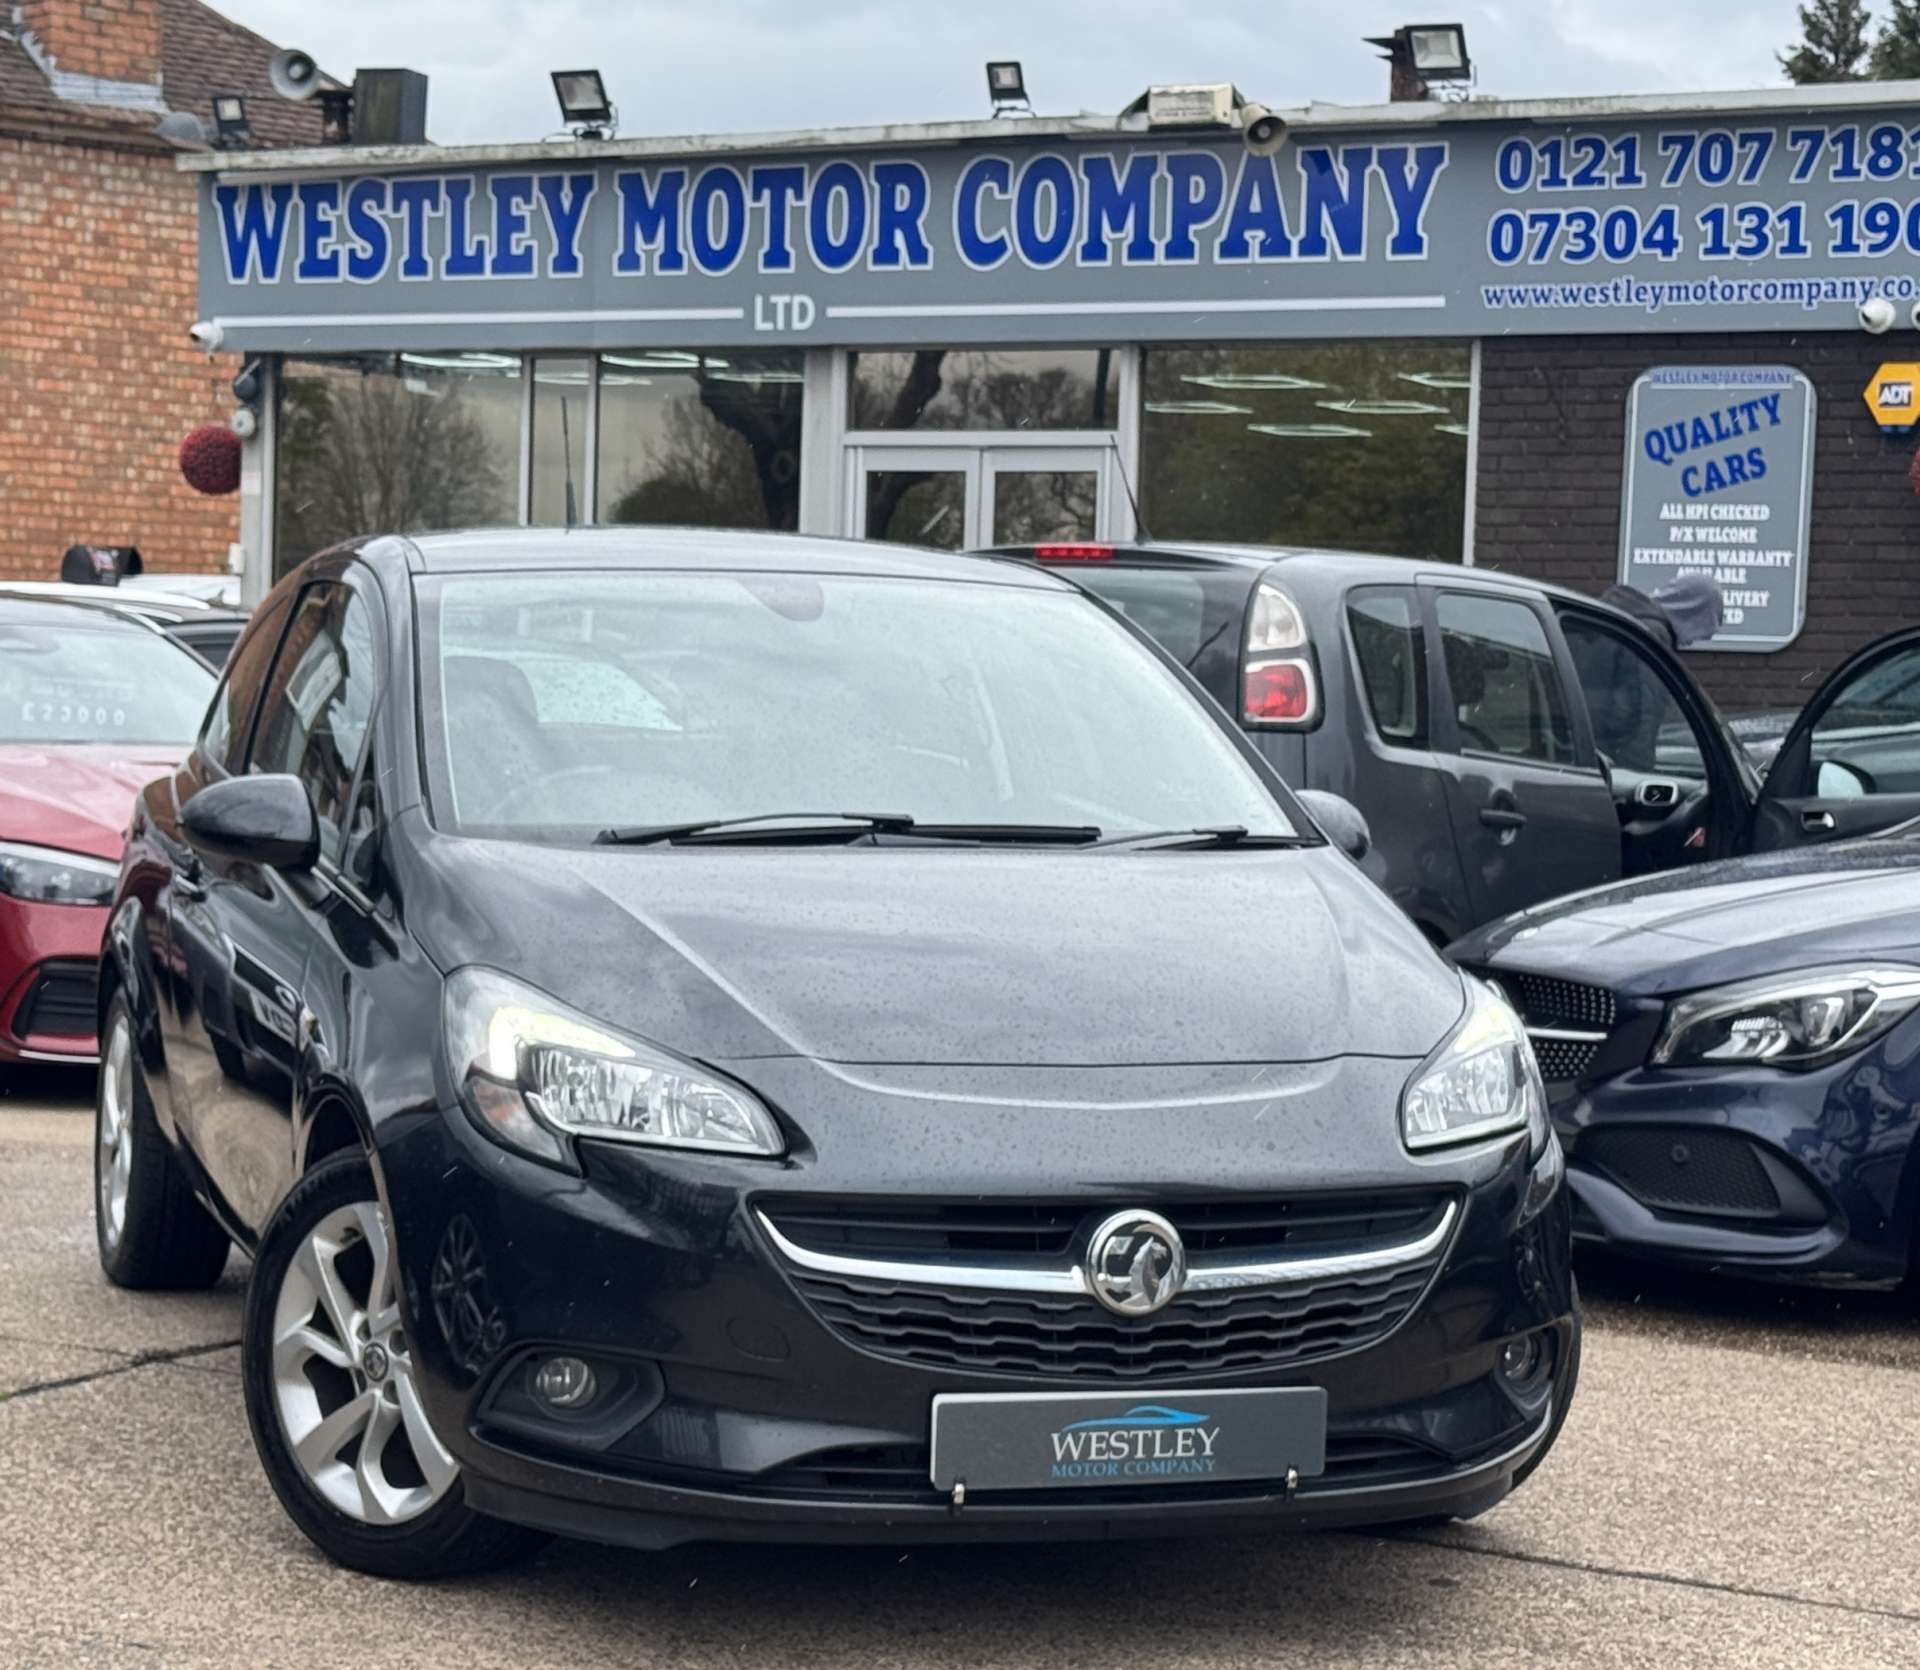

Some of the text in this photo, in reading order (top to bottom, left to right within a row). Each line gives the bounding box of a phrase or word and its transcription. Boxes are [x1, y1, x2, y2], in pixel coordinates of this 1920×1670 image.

[1495, 132, 1645, 193] 0121
[1658, 127, 1776, 187] 707
[213, 142, 1449, 284] WESTLEY MOTOR COMPANY
[1487, 203, 1681, 265] 07304
[1696, 199, 1811, 260] 131
[754, 294, 815, 330] LTD
[1879, 384, 1913, 404] ADT
[1644, 393, 1781, 465] QUALITY
[1681, 447, 1767, 497] CARS
[1659, 503, 1770, 521] ALL HPI CHECKED
[1669, 527, 1758, 544] P/X WELCOME
[1633, 548, 1794, 567] EXTENDABLE WARRANTY
[1051, 1427, 1220, 1463] WESTLEY
[1052, 1457, 1216, 1479] MOTOR COMPANY
